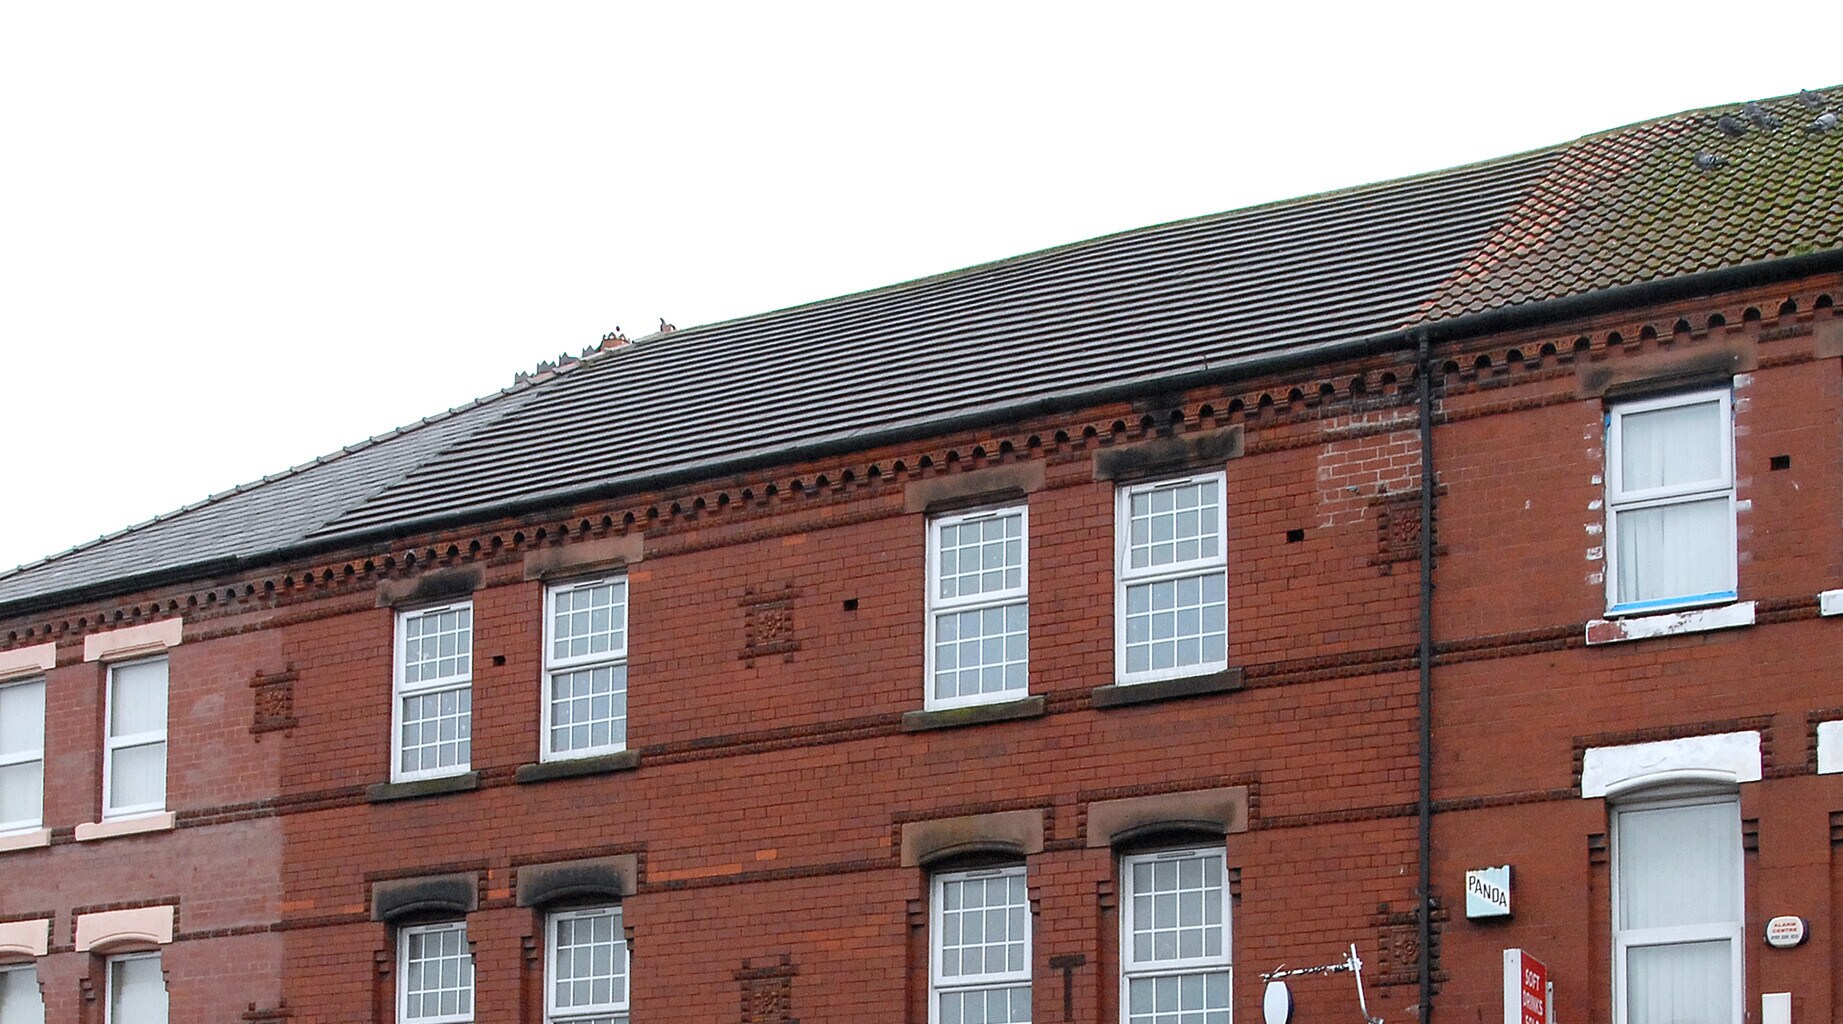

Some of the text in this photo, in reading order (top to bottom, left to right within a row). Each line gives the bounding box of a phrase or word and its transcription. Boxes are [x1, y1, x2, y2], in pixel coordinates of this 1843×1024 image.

[1469, 875, 1507, 907] PANDA
[1525, 968, 1540, 991] SOFT
[1522, 989, 1543, 1016] DRINKS
